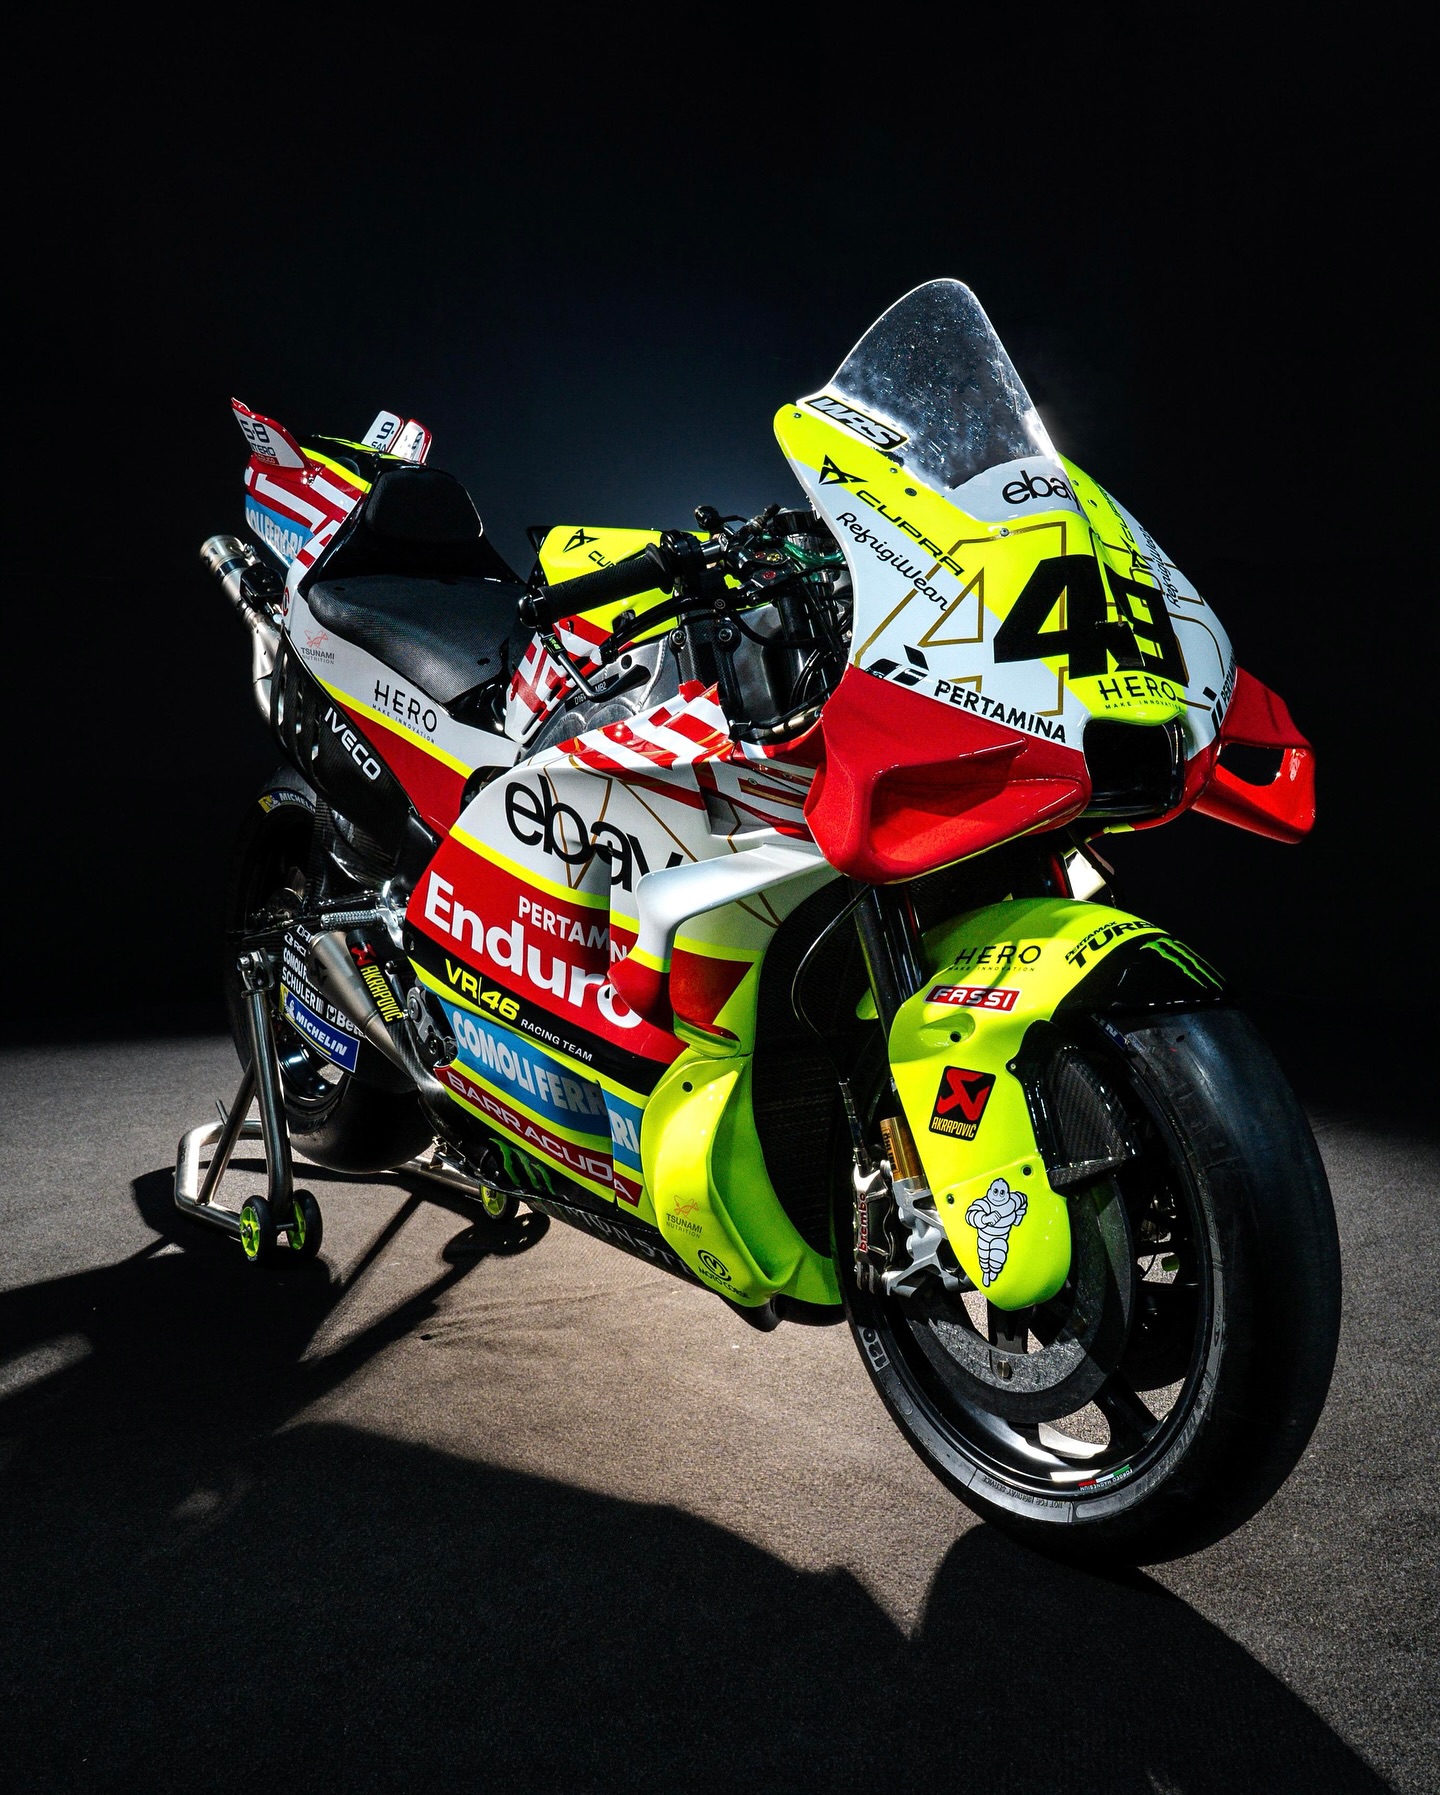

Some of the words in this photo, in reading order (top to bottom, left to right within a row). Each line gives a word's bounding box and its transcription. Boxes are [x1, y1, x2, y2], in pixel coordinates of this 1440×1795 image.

[855, 489, 965, 577] CUPRA
[836, 512, 949, 611] RefrigiWear
[300, 647, 335, 660] TSUNAMI
[374, 679, 438, 733] HERO
[933, 679, 1067, 744] PERTAMINA
[1097, 676, 1177, 702] HERO
[1105, 701, 1132, 710] MAKE
[324, 706, 382, 781] IVECO
[372, 703, 391, 718] MAKE
[395, 716, 436, 744] INNOVATION
[423, 870, 642, 1029] Enduro
[518, 895, 628, 963] PERTAMN
[953, 945, 1042, 965] HERO
[933, 988, 1013, 1008] FASSI
[295, 1011, 348, 1057] MICHELIN
[520, 1018, 560, 1046] RACING
[563, 1040, 593, 1062] TEAM
[452, 1010, 537, 1096] COMOLI
[533, 1063, 641, 1154] FERRRI
[447, 1071, 635, 1201] BARRACUDA
[666, 1213, 703, 1234] TSUNAMI
[666, 1221, 701, 1239] NUTRITION
[858, 1193, 869, 1253] brembo
